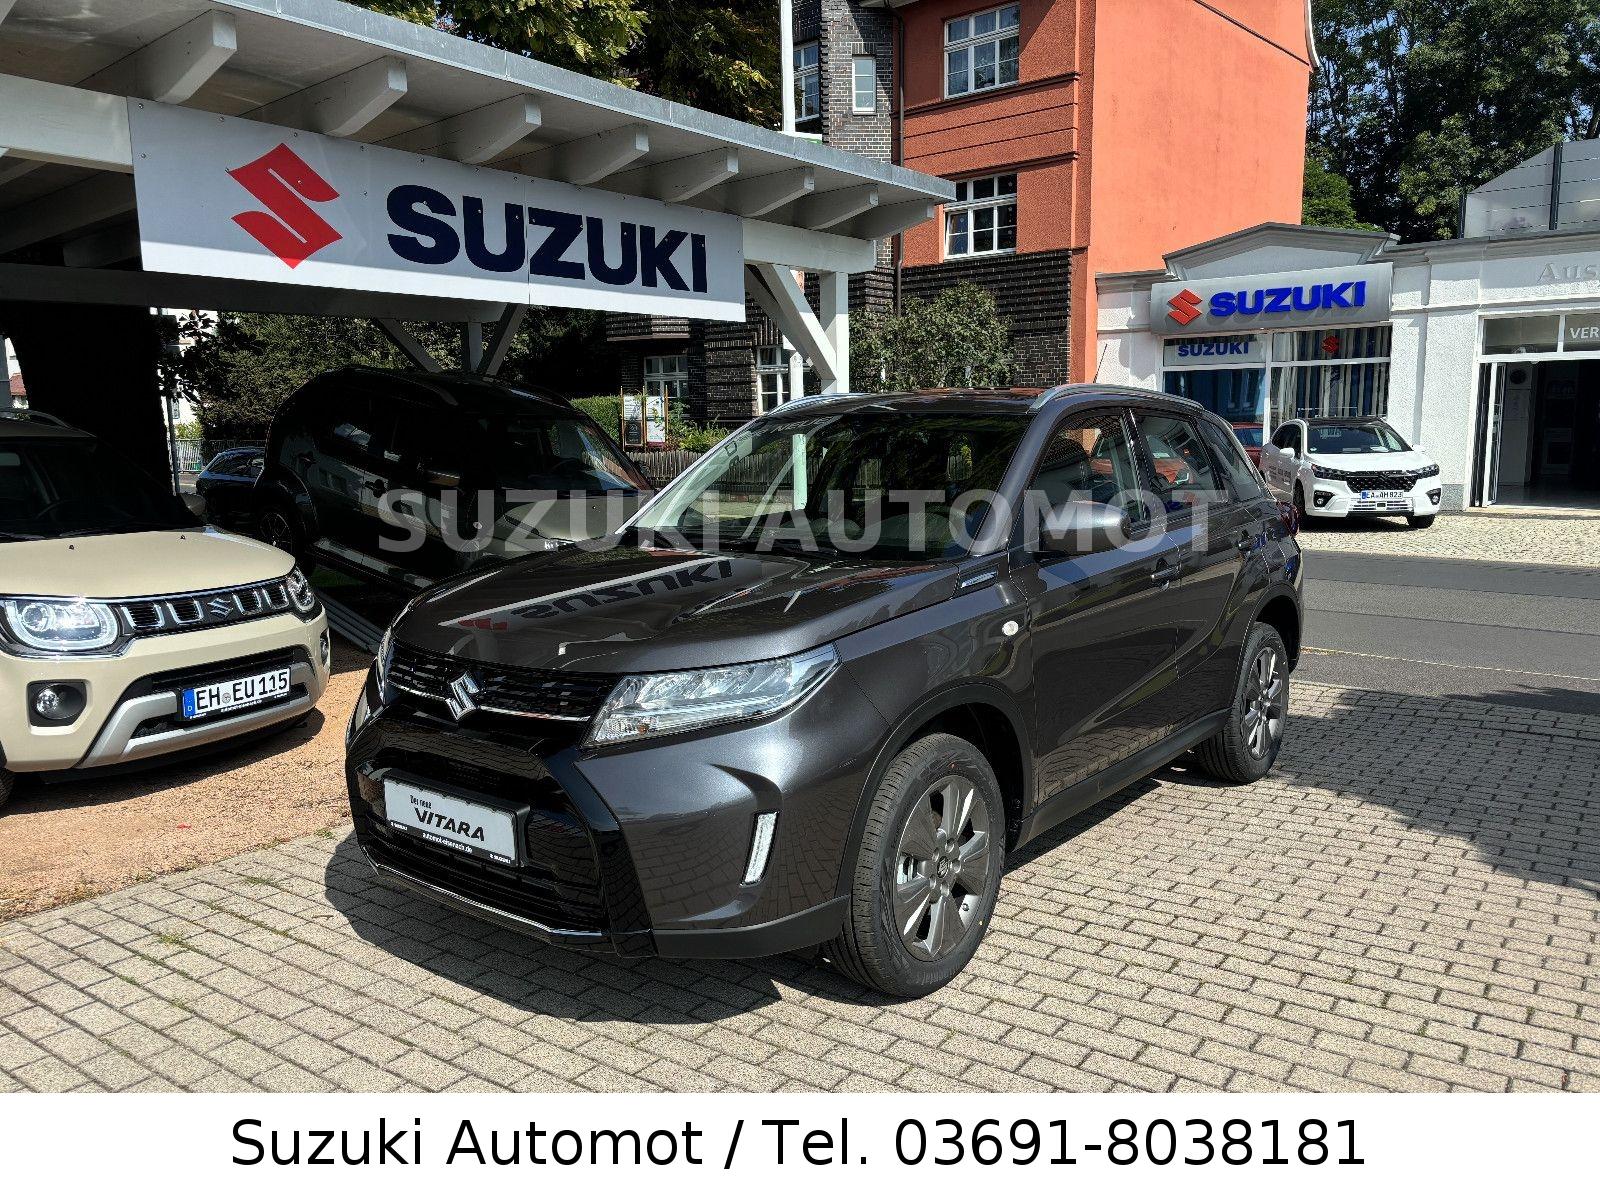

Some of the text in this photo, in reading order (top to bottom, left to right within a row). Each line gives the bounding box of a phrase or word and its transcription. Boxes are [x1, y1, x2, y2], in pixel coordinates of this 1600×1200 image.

[386, 184, 708, 293] SUZUKI
[1209, 281, 1366, 317] SUZUKI
[1177, 341, 1249, 357] SUZUKI
[196, 686, 220, 711] EH
[232, 679, 255, 703] EU
[259, 671, 288, 696] 115
[414, 807, 485, 842] VITARA
